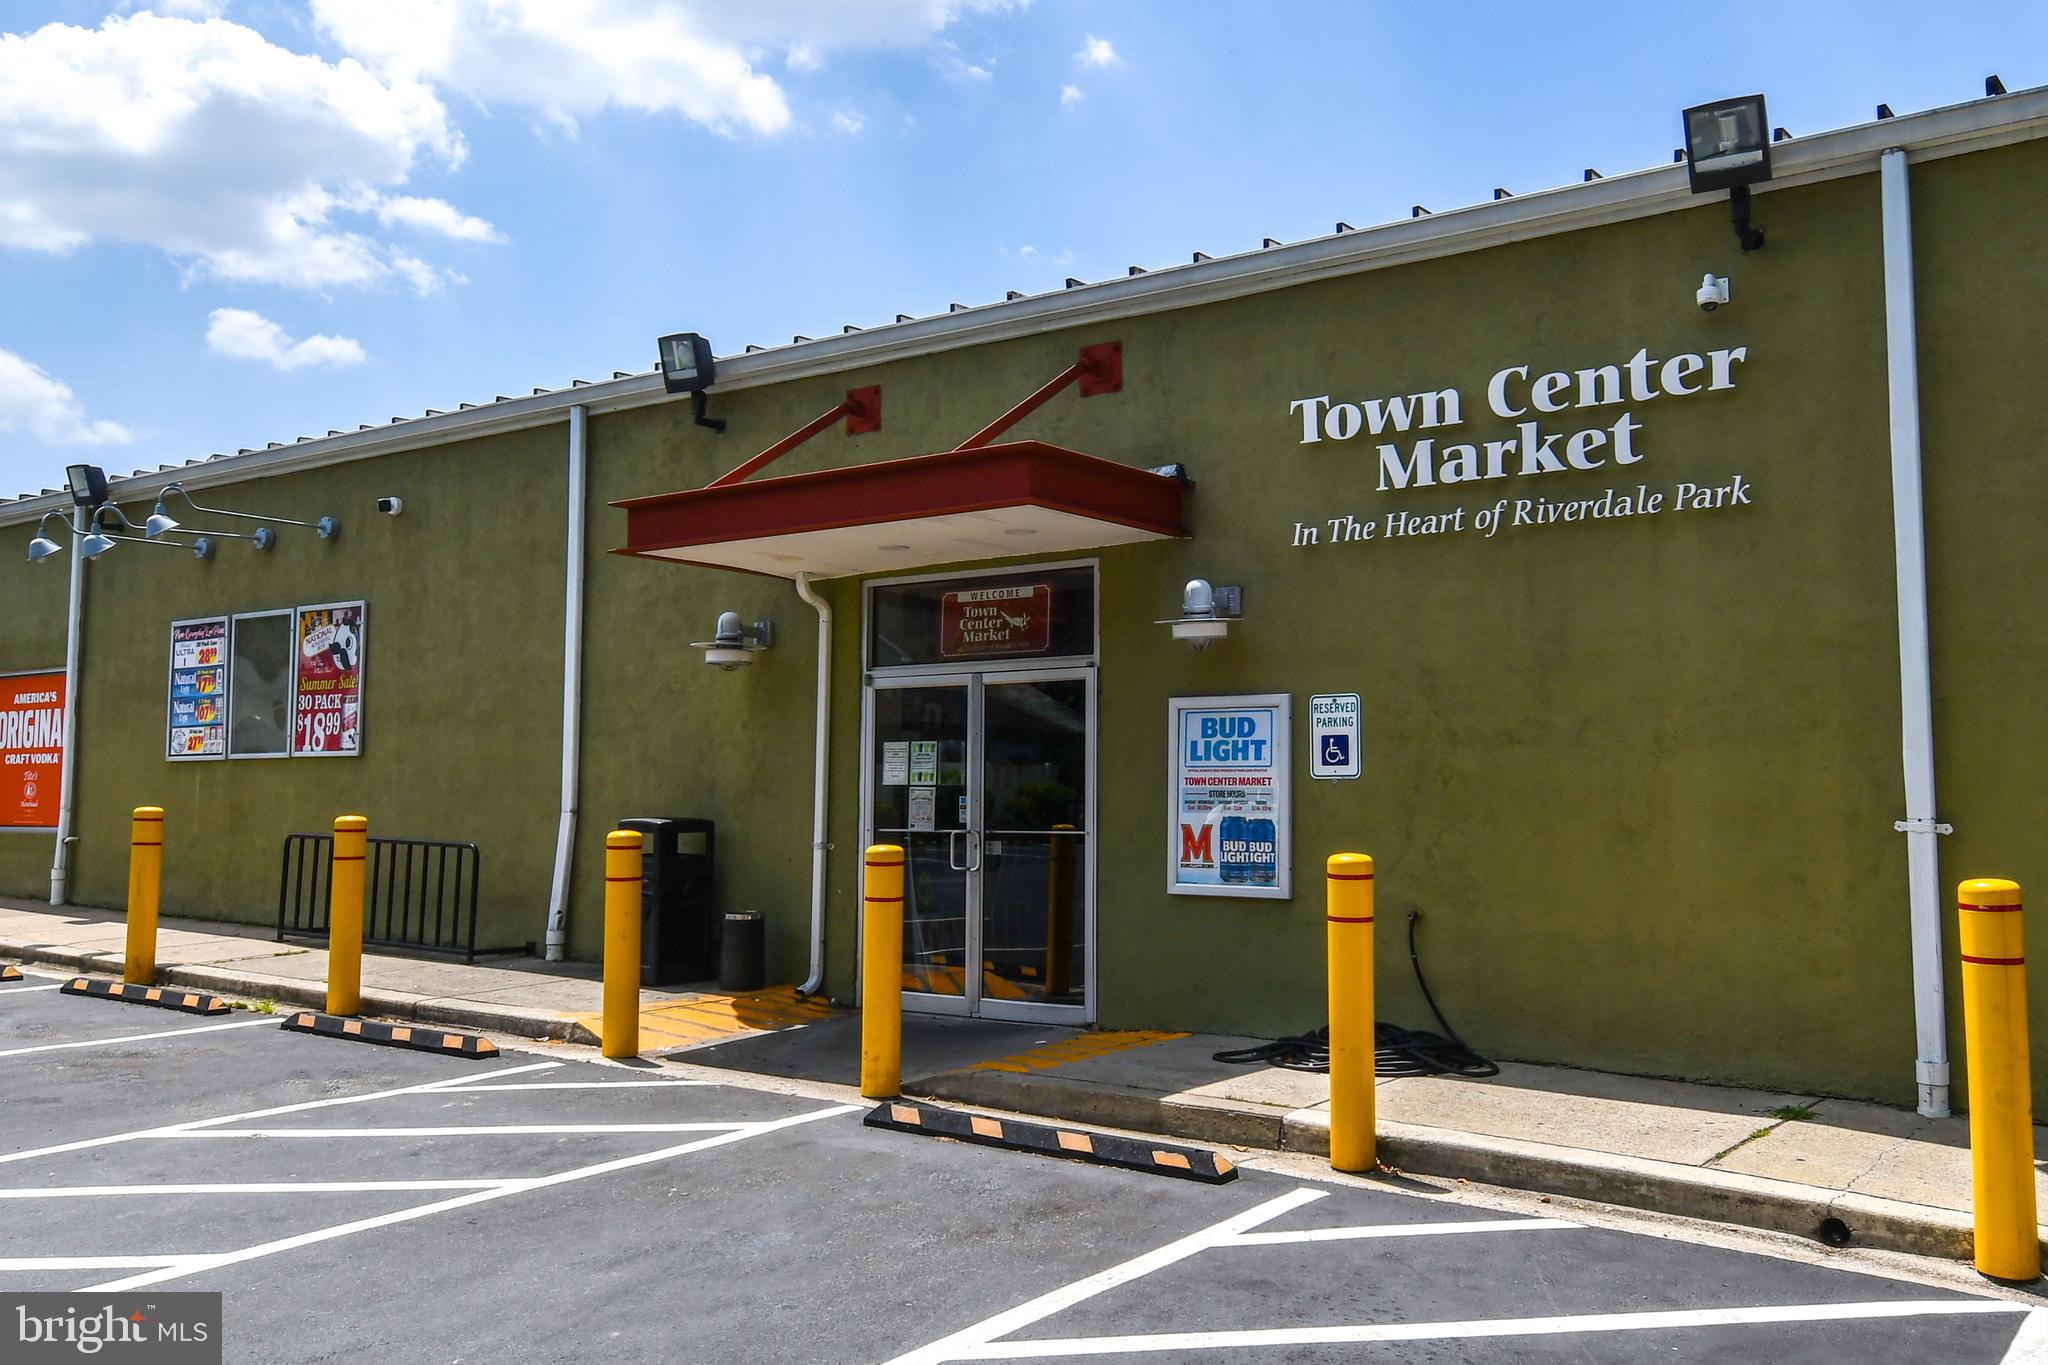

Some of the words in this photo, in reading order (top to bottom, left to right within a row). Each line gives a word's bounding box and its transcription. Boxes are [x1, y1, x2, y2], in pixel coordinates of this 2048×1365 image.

[1290, 387, 1463, 444] Town
[1487, 346, 1747, 418] Center
[1375, 412, 1644, 491] Market
[1291, 522, 1319, 547] In
[1328, 515, 1376, 543] The
[1384, 508, 1465, 539] Heart
[1474, 500, 1507, 538] of
[1512, 485, 1664, 526] Riverdale
[1673, 475, 1752, 511] Park
[970, 588, 1021, 600] WELCOME
[963, 606, 998, 618] Town
[959, 617, 1004, 631] Center
[305, 627, 334, 645] NATIONAL
[962, 628, 1011, 643] Market
[175, 648, 195, 657] ULTRA
[300, 677, 337, 692] Summer
[339, 673, 359, 689] Sale!
[14, 691, 58, 705] AMERICA'S
[298, 695, 312, 710] 30
[314, 694, 342, 710] PACK
[1313, 702, 1356, 714] RESERVED
[0, 707, 65, 749] ORIGINA
[1201, 716, 1256, 739] BUD
[1316, 716, 1354, 728] PARKING
[1190, 739, 1267, 762] LIGHT
[5, 754, 30, 765] CRAFT
[31, 752, 59, 764] VODKA
[1184, 777, 1207, 787] TOWN
[1208, 777, 1237, 786] CENTER
[1238, 776, 1273, 786] MARKET
[1208, 790, 1226, 798] STORE
[1222, 840, 1247, 852] BUD
[1249, 841, 1273, 852] BUD
[1220, 851, 1249, 863] LIGHT
[1249, 852, 1276, 863] IGHT
